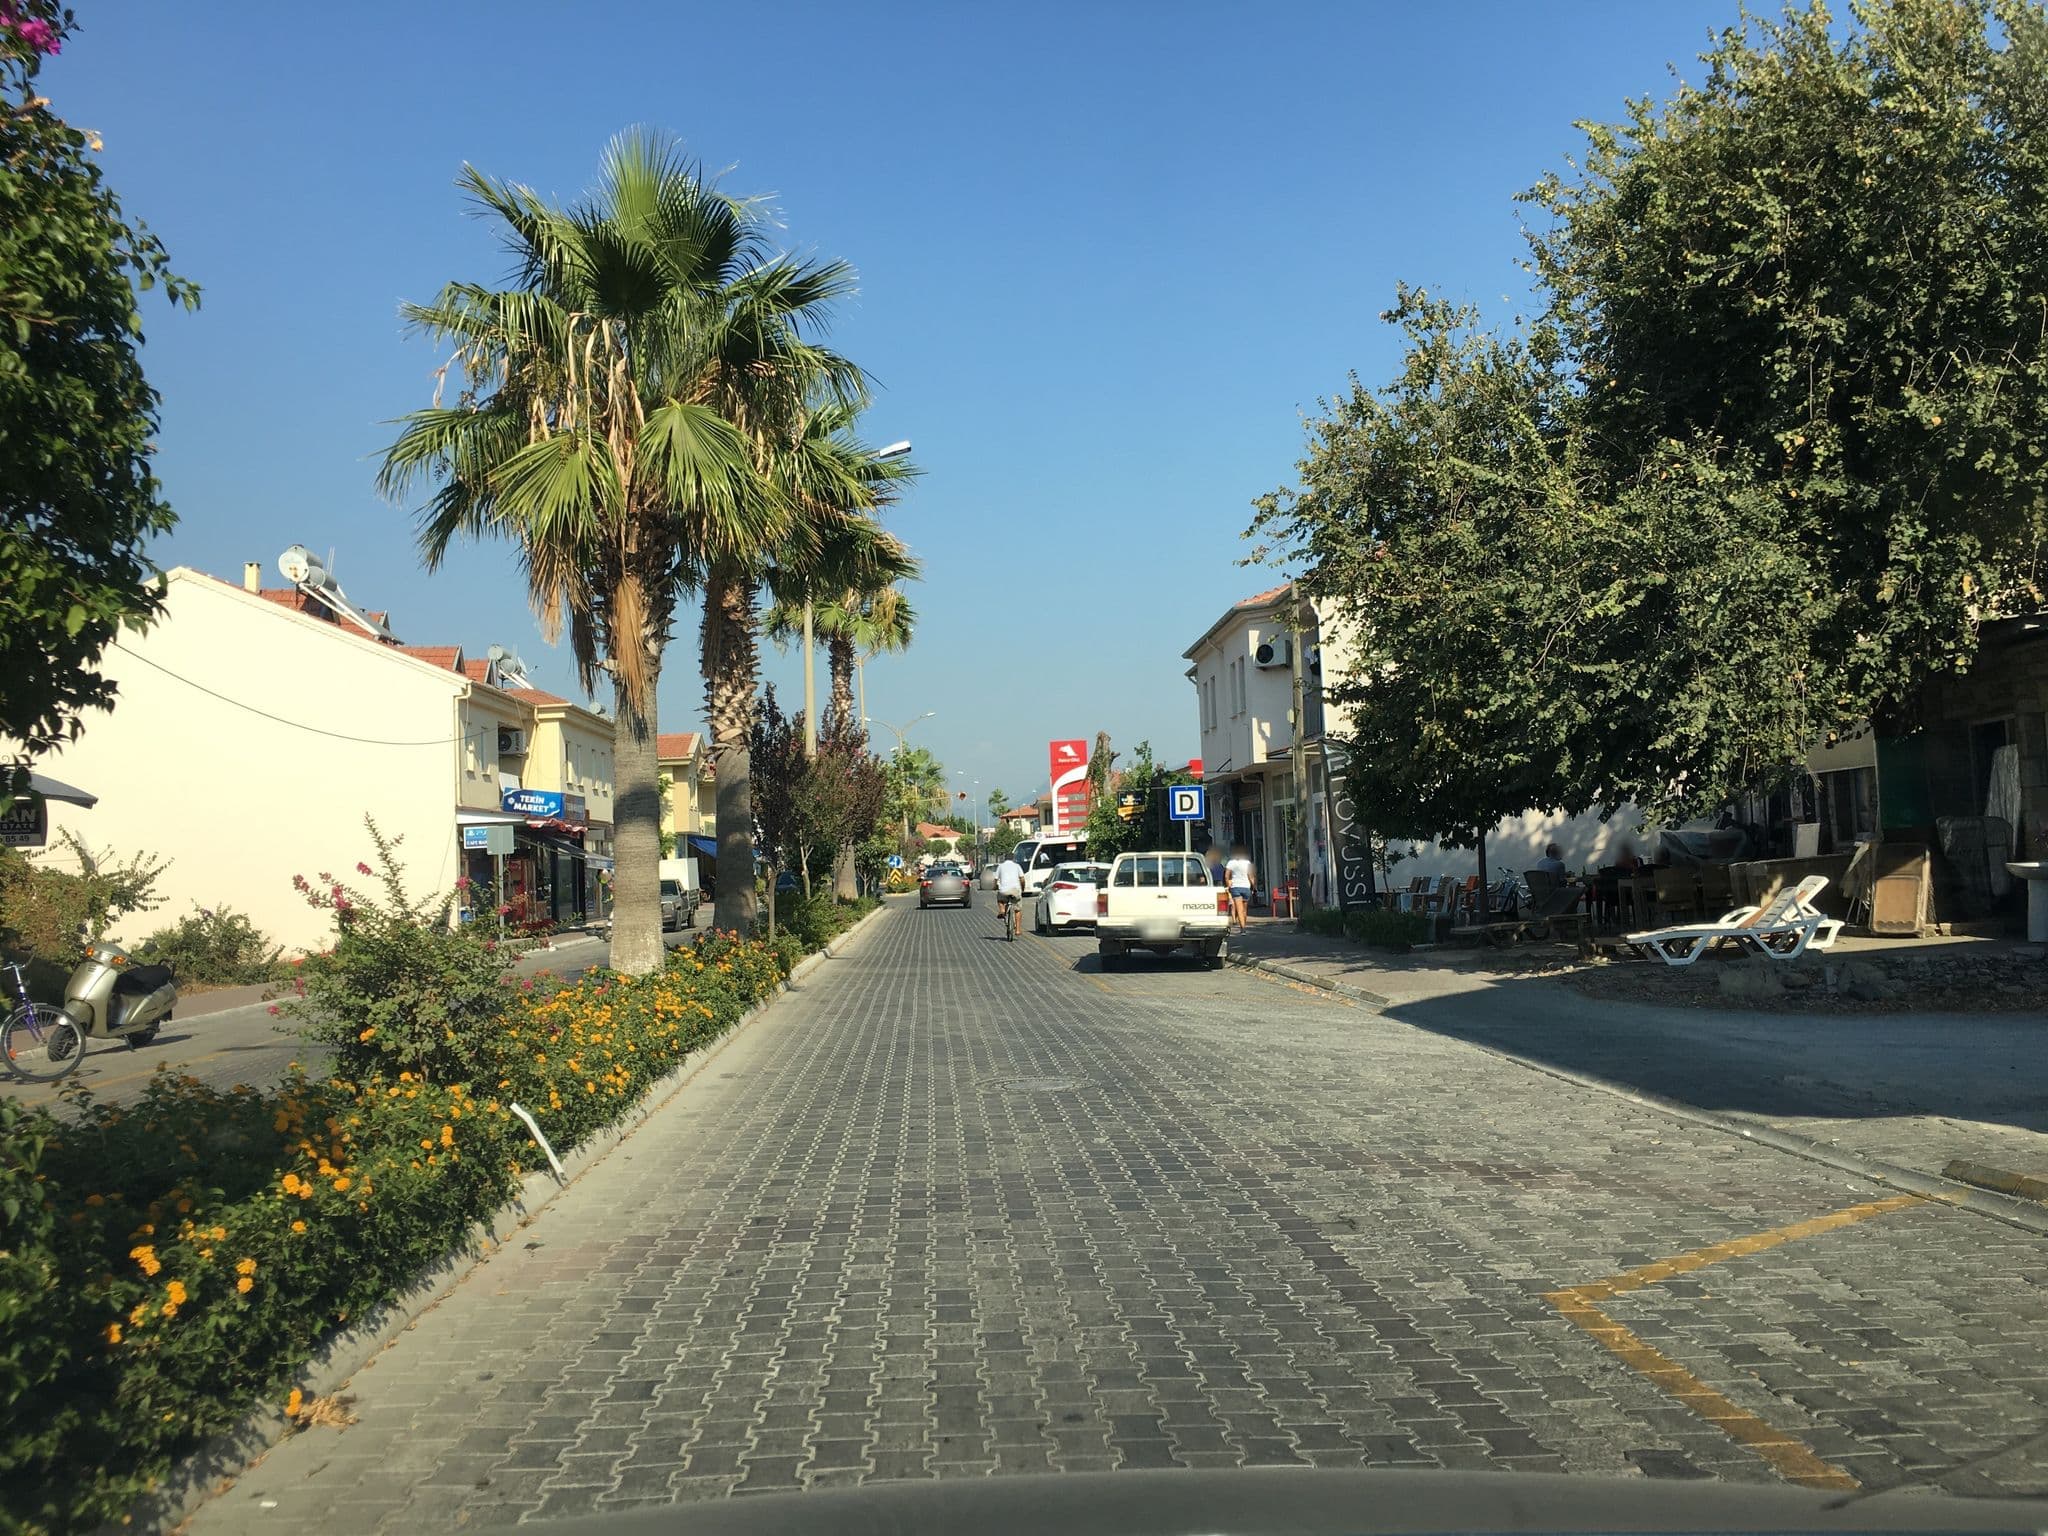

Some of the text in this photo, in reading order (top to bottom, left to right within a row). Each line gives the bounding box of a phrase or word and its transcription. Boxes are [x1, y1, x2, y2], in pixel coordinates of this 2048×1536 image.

[520, 794, 545, 804] TEKİN
[1179, 794, 1194, 812] D
[513, 803, 549, 813] MARKET
